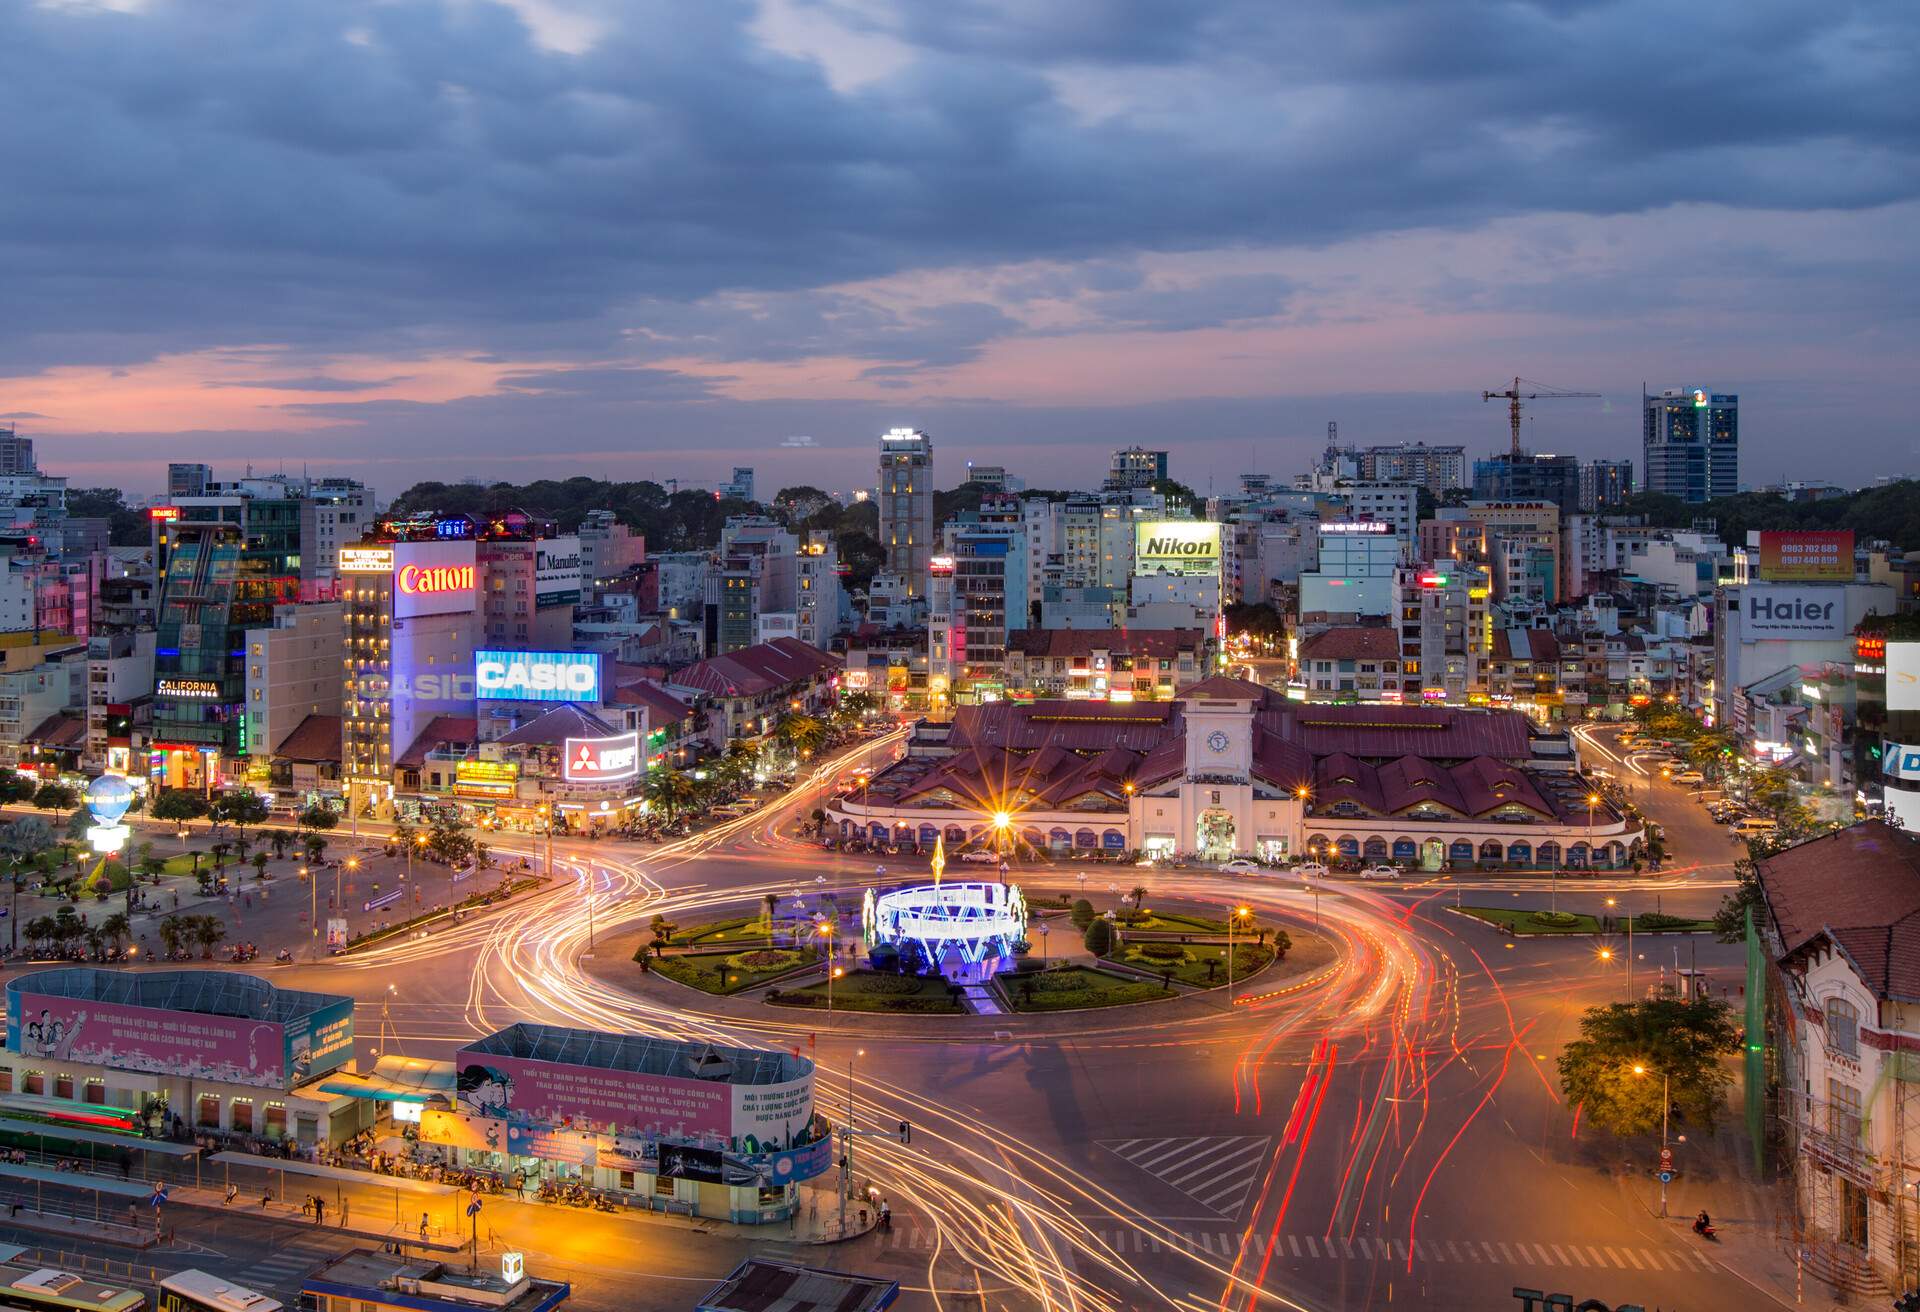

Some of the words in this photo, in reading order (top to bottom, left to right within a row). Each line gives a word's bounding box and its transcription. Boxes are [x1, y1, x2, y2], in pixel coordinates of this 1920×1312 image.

[1147, 538, 1211, 554] Nikon
[547, 554, 579, 570] Manulife
[400, 565, 473, 593] Canon
[1751, 598, 1834, 620] Haier
[159, 680, 216, 691] CALIFORNIA
[477, 662, 595, 691] CASIO
